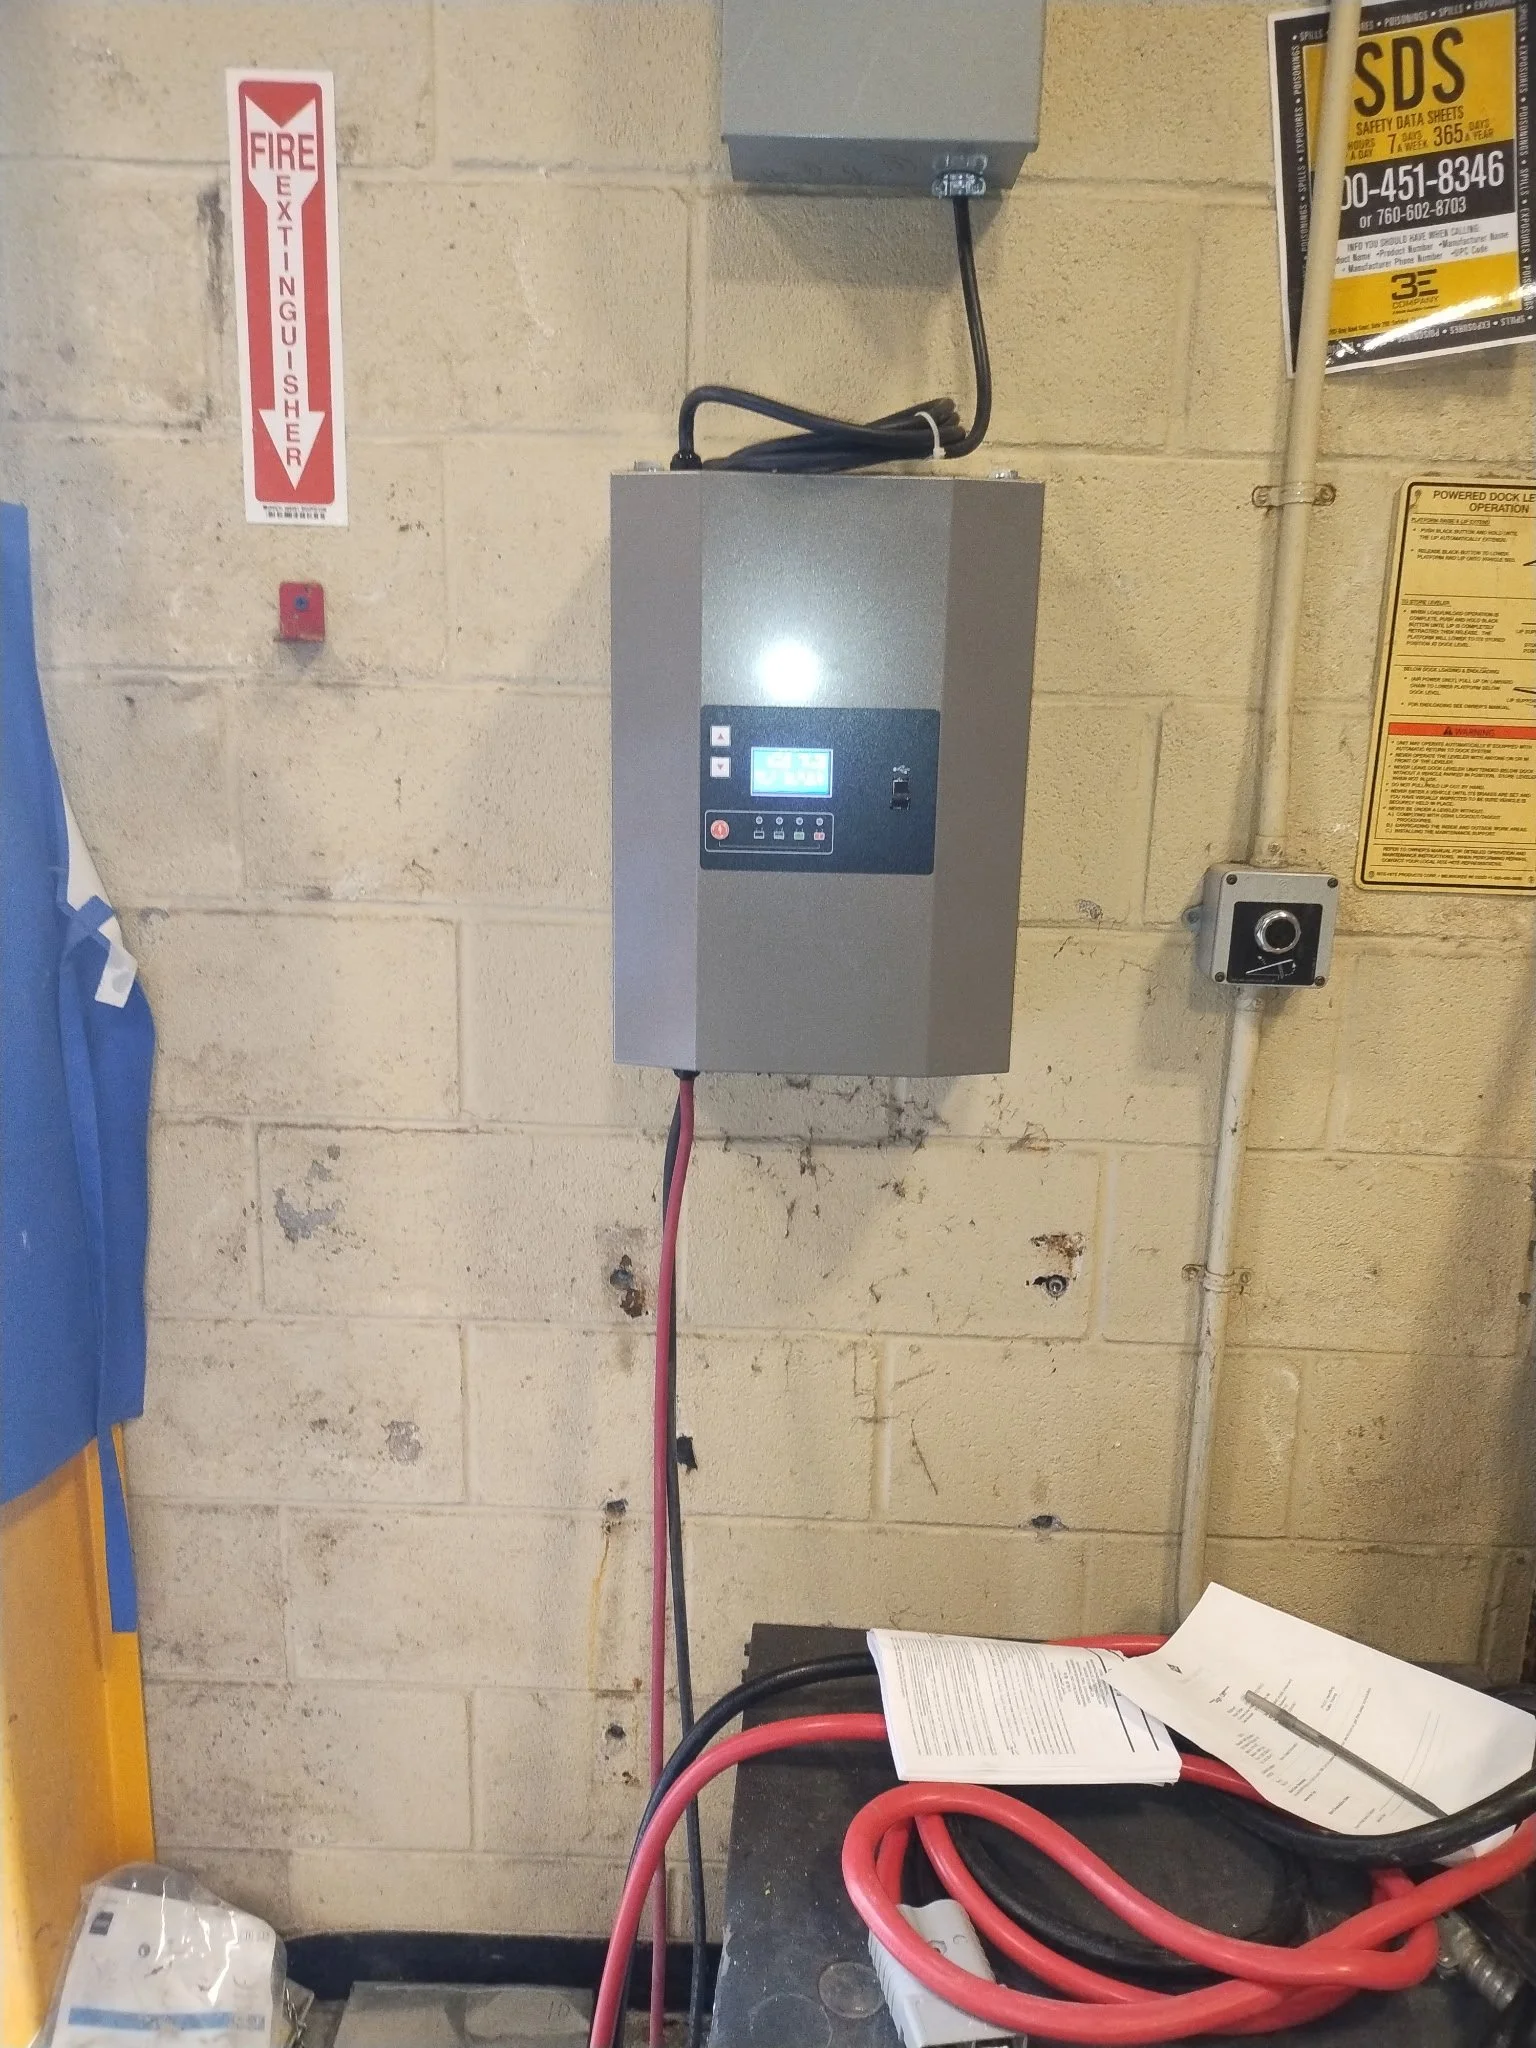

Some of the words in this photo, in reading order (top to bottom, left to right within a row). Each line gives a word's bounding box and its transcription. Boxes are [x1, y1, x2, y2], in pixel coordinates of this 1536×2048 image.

[1291, 44, 1302, 95] POISONINGS
[1354, 27, 1465, 117] SDS
[1519, 45, 1528, 94] EXPOSURES
[1294, 106, 1304, 153] EXPOSURES
[1356, 118, 1393, 135] SAFETY
[1396, 113, 1424, 129] DATA
[1427, 105, 1464, 124] SHEETS
[1519, 106, 1529, 156] POISONINGS
[250, 132, 316, 170] FIRE
[1359, 148, 1373, 159] DAY
[1405, 139, 1428, 151] WEEK
[1473, 128, 1494, 140] YEAR
[1387, 133, 1396, 154] 7
[1402, 130, 1423, 142] DAYS
[1433, 123, 1463, 147] 365
[1469, 118, 1490, 131] DAYS
[1297, 165, 1307, 193] SPILLS
[1520, 168, 1529, 196] SPILLS
[1359, 214, 1371, 229] or
[1377, 197, 1467, 226] 760-602-8703
[1347, 241, 1363, 252] INFO
[1364, 240, 1379, 249] YOU
[1379, 235, 1407, 248] SHOULD
[1409, 232, 1426, 242] HAVE
[1428, 228, 1449, 239] WHEN
[1352, 252, 1371, 261] Name
[1408, 243, 1433, 253] Number
[1490, 231, 1509, 241] Name
[1520, 208, 1530, 254] EXPOSURES
[1348, 260, 1391, 273] Manufacturer
[1395, 256, 1415, 266] Phone
[1417, 252, 1443, 263] Number
[1471, 244, 1488, 254] Code
[1391, 268, 1438, 300] 3E
[1392, 296, 1439, 309] COMPANY
[276, 175, 302, 467] EXTINGUISHER
[1433, 490, 1487, 500] POWERED
[1489, 492, 1520, 501] DOCK
[1469, 503, 1530, 513] OPERATION
[1455, 728, 1495, 736] WARNING
